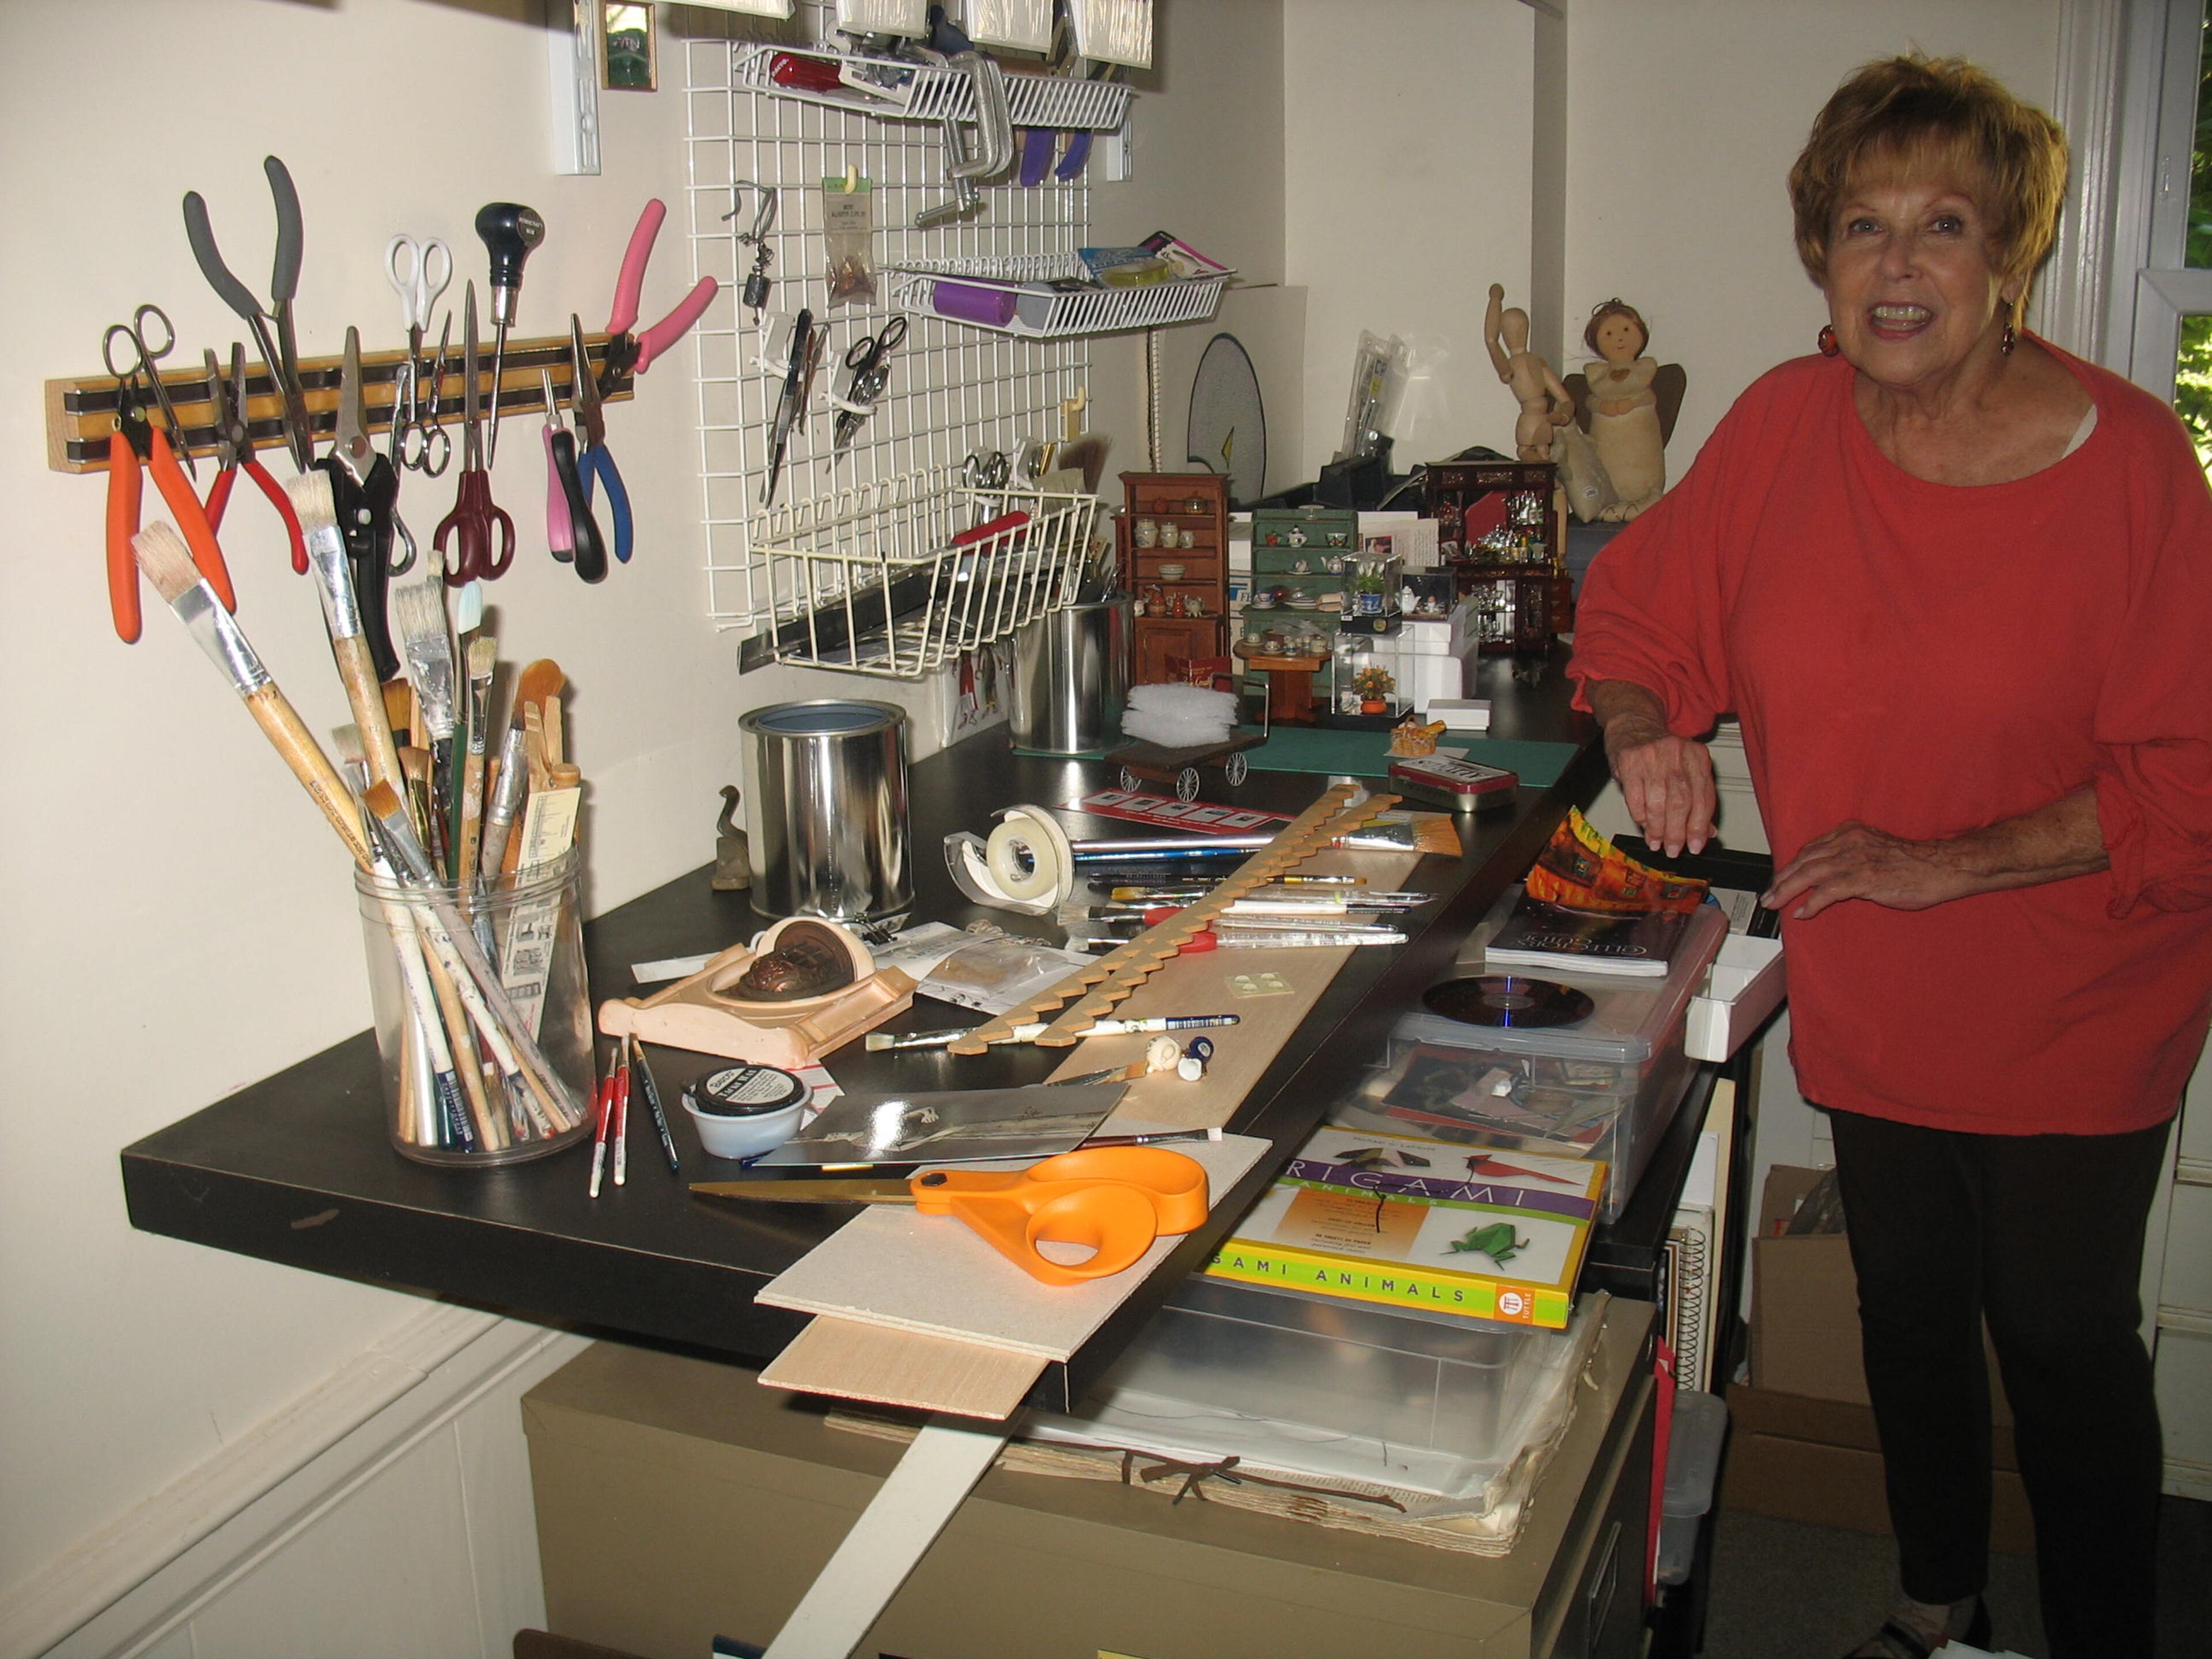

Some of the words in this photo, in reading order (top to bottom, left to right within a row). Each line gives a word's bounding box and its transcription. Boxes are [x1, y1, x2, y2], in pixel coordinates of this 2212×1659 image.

[1300, 1180, 1438, 1206] ANIMALS
[1316, 1269, 1464, 1302] ANIMALS
[1522, 1293, 1532, 1319] TUTTLE
